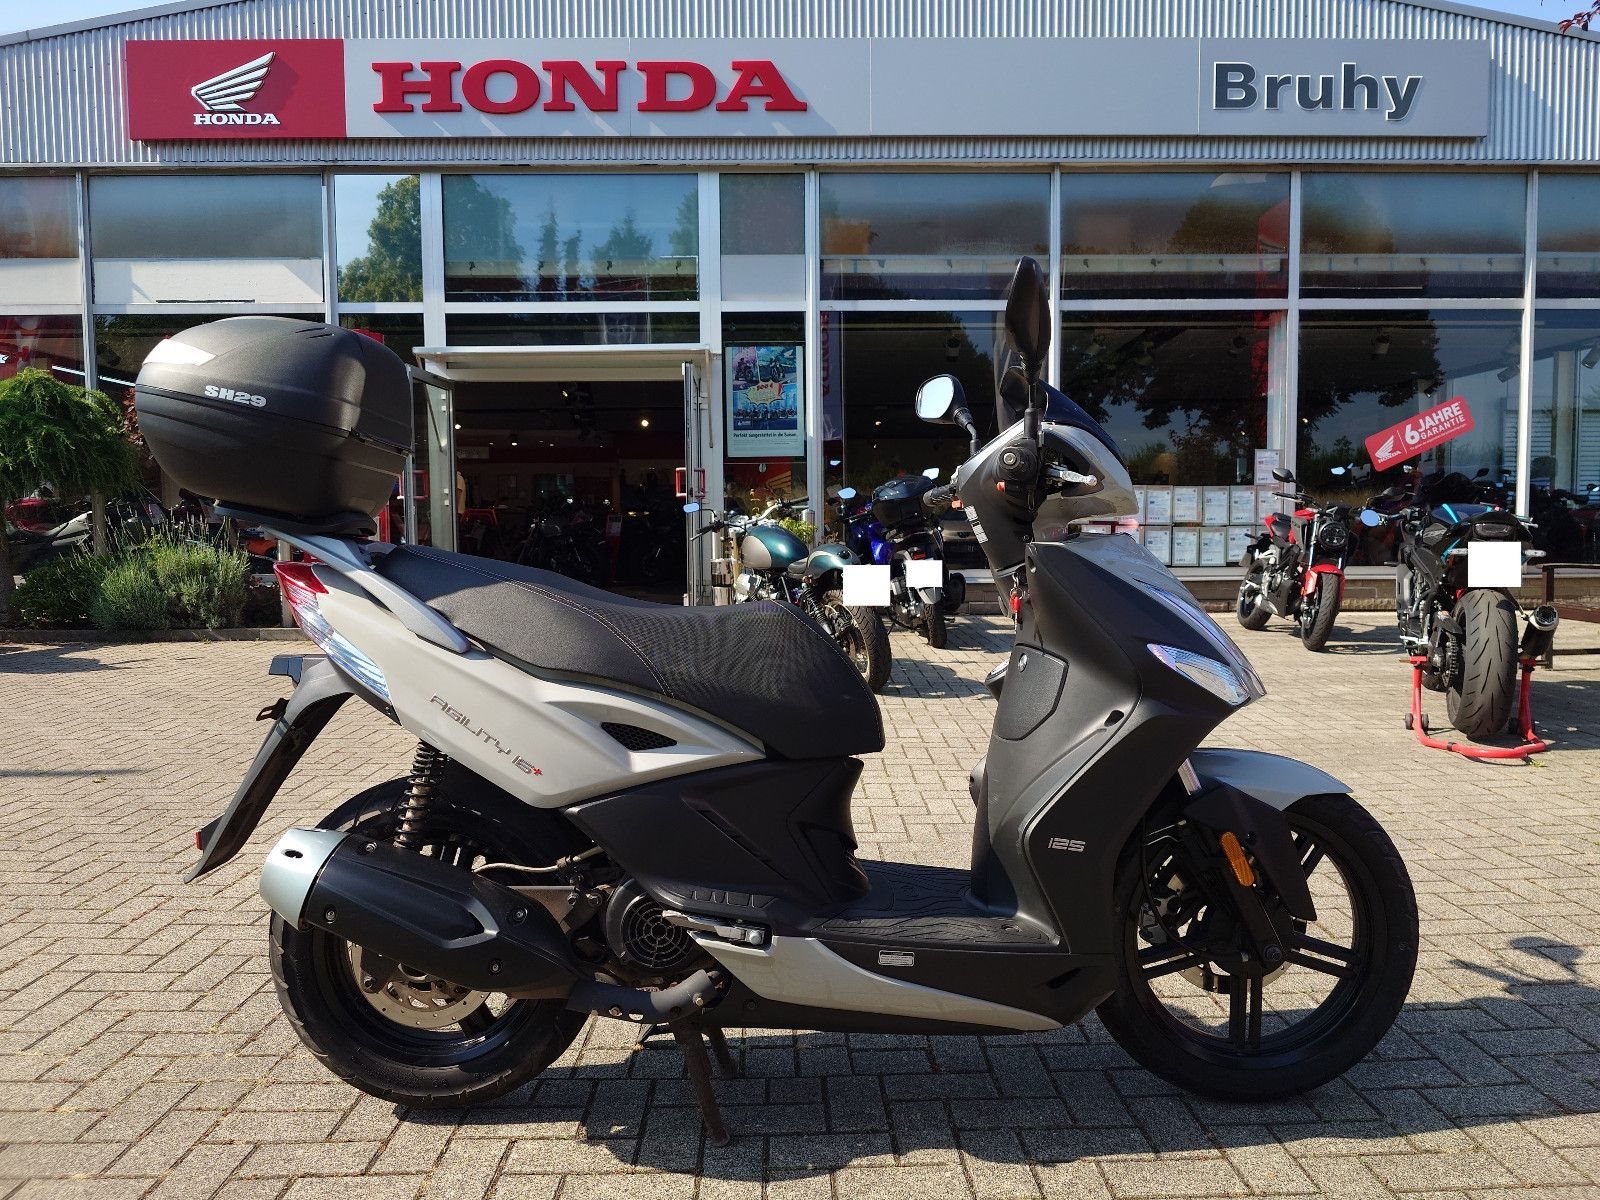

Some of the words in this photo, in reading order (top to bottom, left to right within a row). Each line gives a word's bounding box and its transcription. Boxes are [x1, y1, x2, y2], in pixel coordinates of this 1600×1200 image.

[371, 58, 808, 115] HONDA
[1213, 61, 1424, 121] Bruhy
[193, 113, 281, 126] HONDA
[204, 385, 267, 408] SH29
[1405, 423, 1420, 445] 6
[1418, 403, 1462, 432] JAHRE
[1420, 414, 1465, 439] GARANTIE
[429, 695, 512, 755] AGILITY
[1045, 834, 1086, 853] 125
